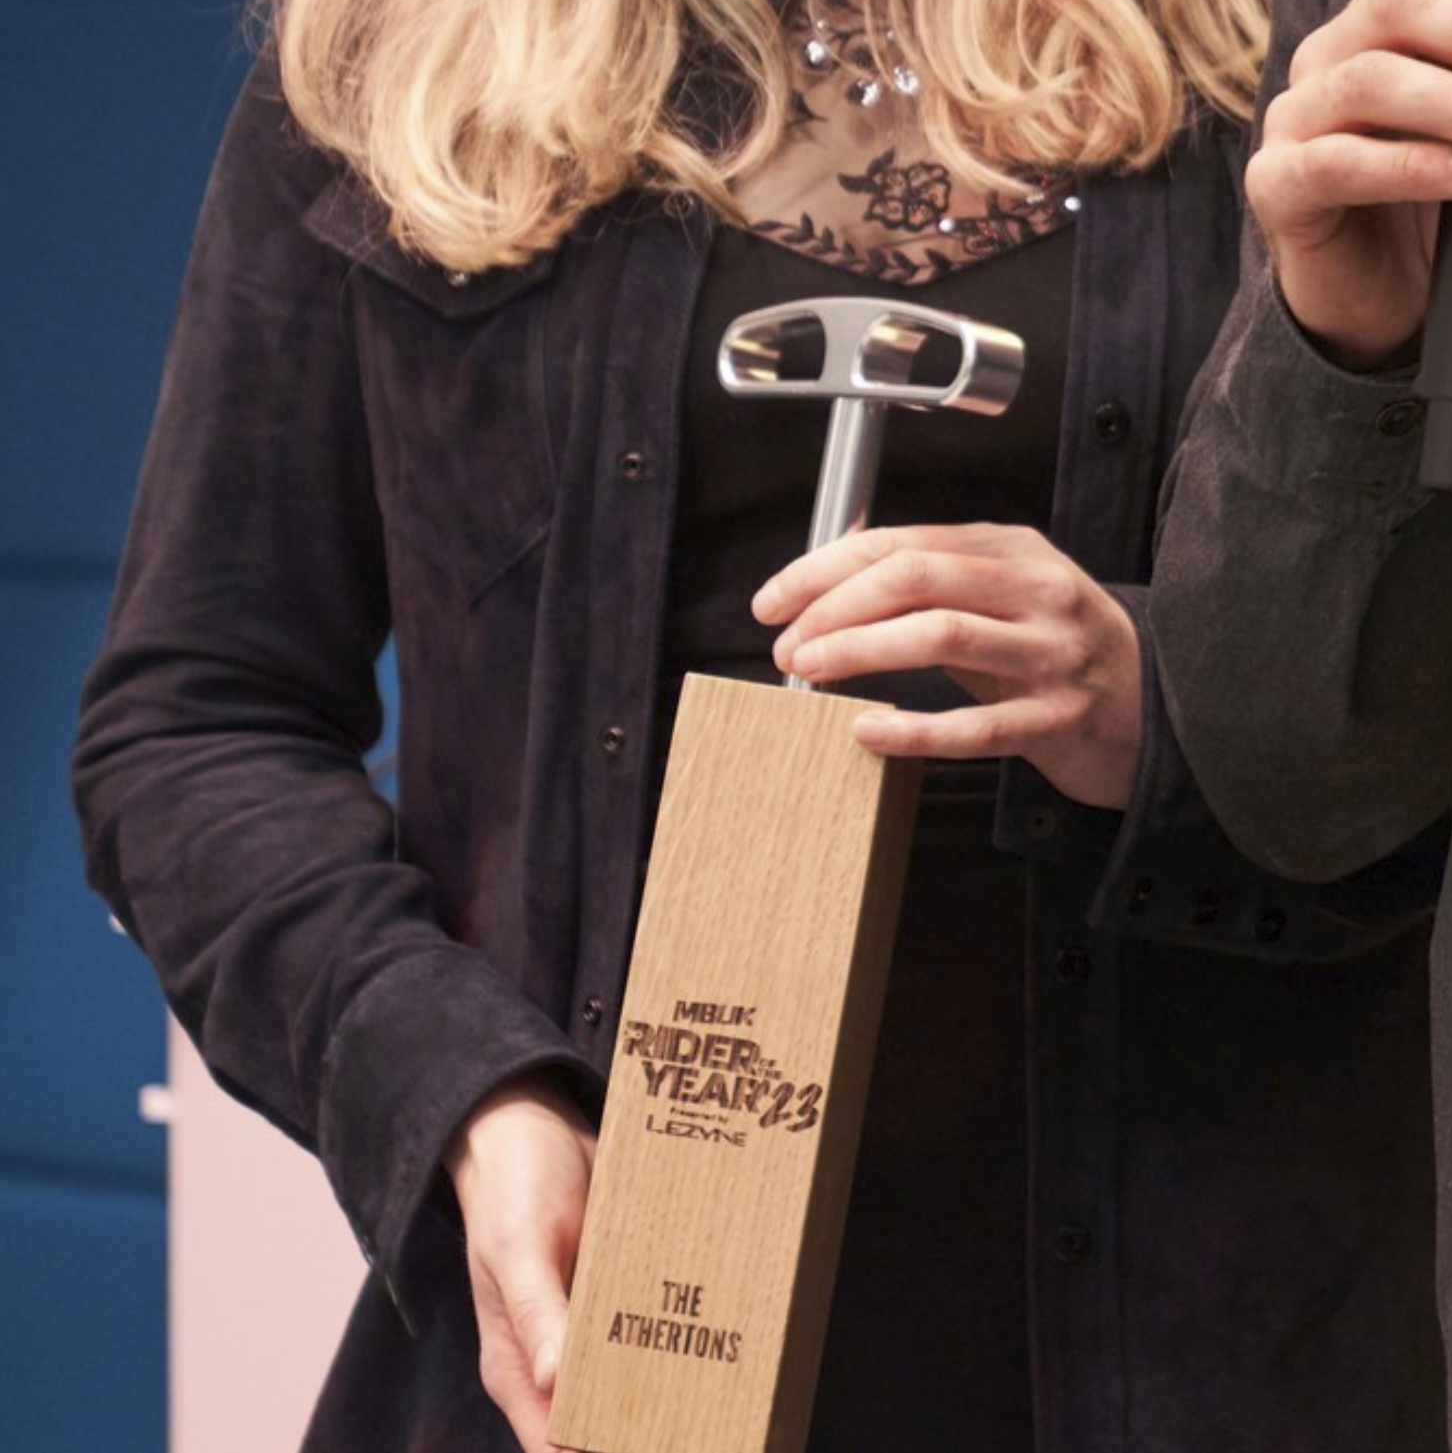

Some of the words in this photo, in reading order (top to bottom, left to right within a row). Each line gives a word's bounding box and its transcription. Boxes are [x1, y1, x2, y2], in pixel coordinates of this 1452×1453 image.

[673, 1000, 757, 1026] MBUK
[624, 1020, 761, 1075] RIDER
[641, 1060, 761, 1113] YEAR
[645, 1115, 747, 1147] LEZYNE
[661, 1280, 704, 1317] THE
[606, 1311, 743, 1363] ATHERTONS
